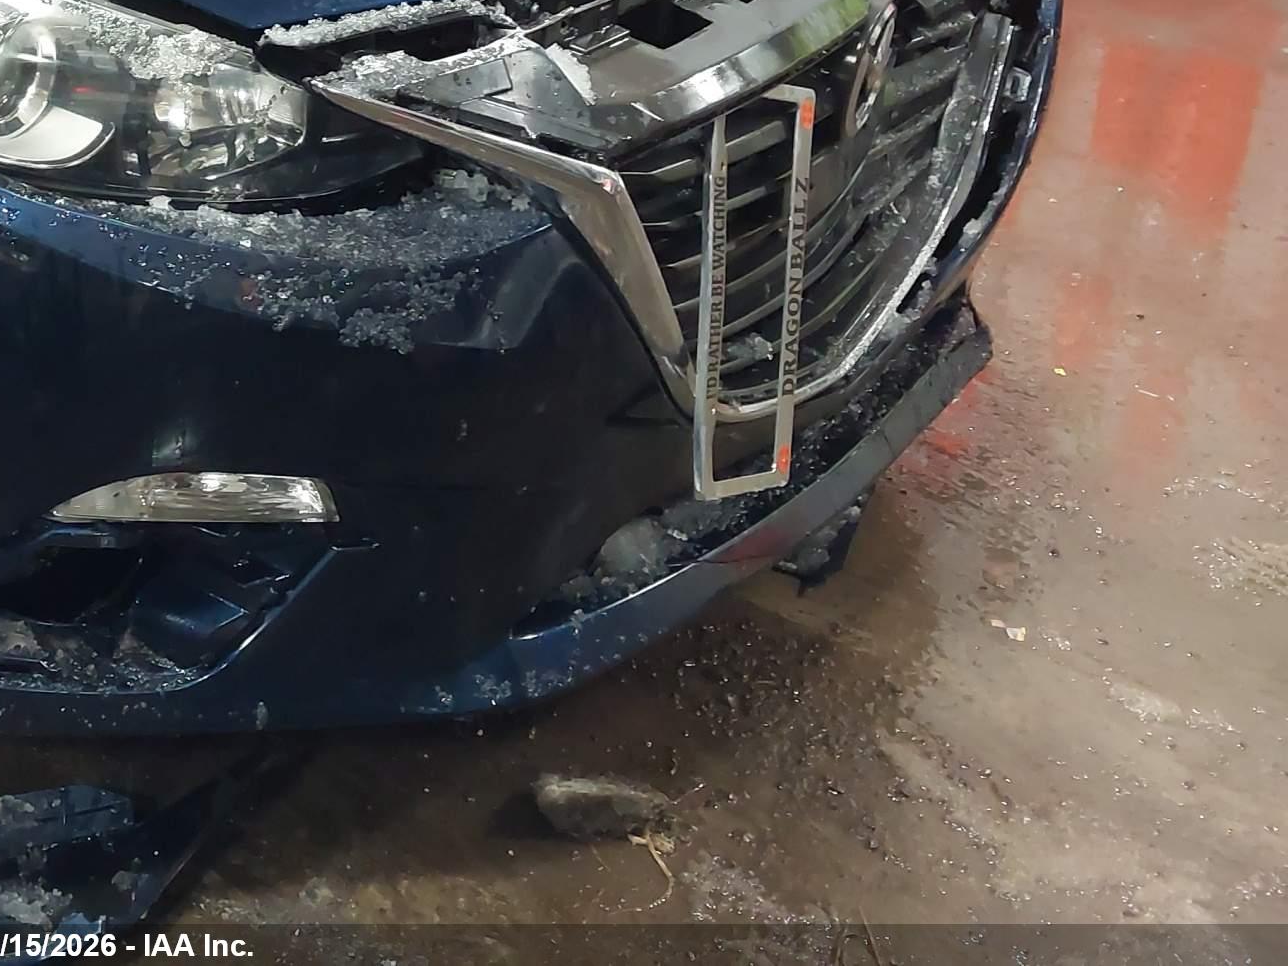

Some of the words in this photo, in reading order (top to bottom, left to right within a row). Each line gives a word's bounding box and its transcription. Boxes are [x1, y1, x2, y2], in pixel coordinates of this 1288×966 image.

[795, 177, 809, 193] Z
[712, 176, 725, 270] WATCHING
[791, 199, 807, 270] BALL
[712, 274, 724, 297] BE
[708, 301, 722, 373] RATHER
[782, 276, 802, 396] DRAGON
